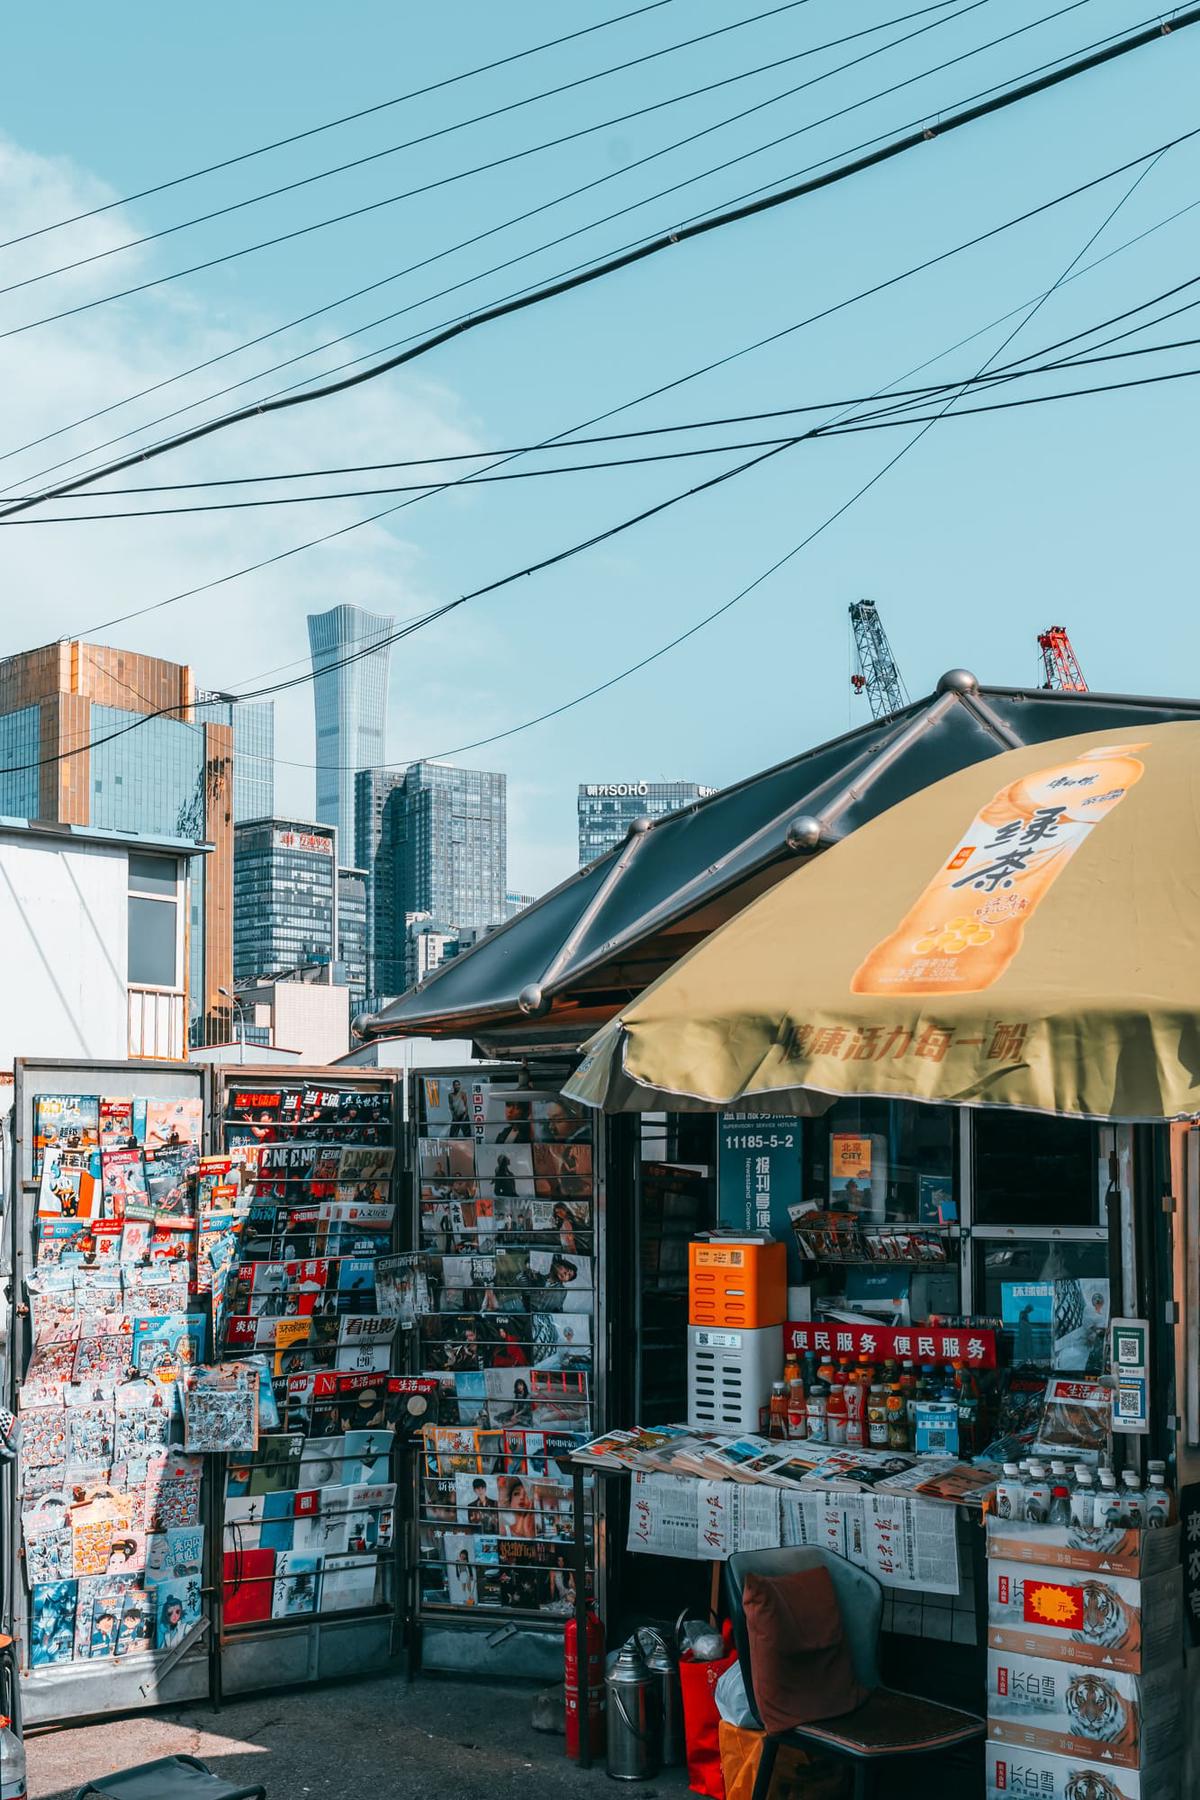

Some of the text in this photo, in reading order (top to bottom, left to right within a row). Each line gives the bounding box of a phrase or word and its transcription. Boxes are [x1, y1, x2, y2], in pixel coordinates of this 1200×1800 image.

[426, 1080, 440, 1107] W
[726, 1135, 794, 1148] 11185-5-2
[756, 1157, 770, 1237] 报刊亭便
[346, 1318, 397, 1335] 看电影
[791, 1330, 986, 1359] 便民服务 便民服务
[635, 1500, 650, 1544] 人民日报
[874, 1518, 895, 1574] 北京日报
[1011, 1670, 1055, 1697] 长白雪
[1010, 1764, 1054, 1792] 长白雪
